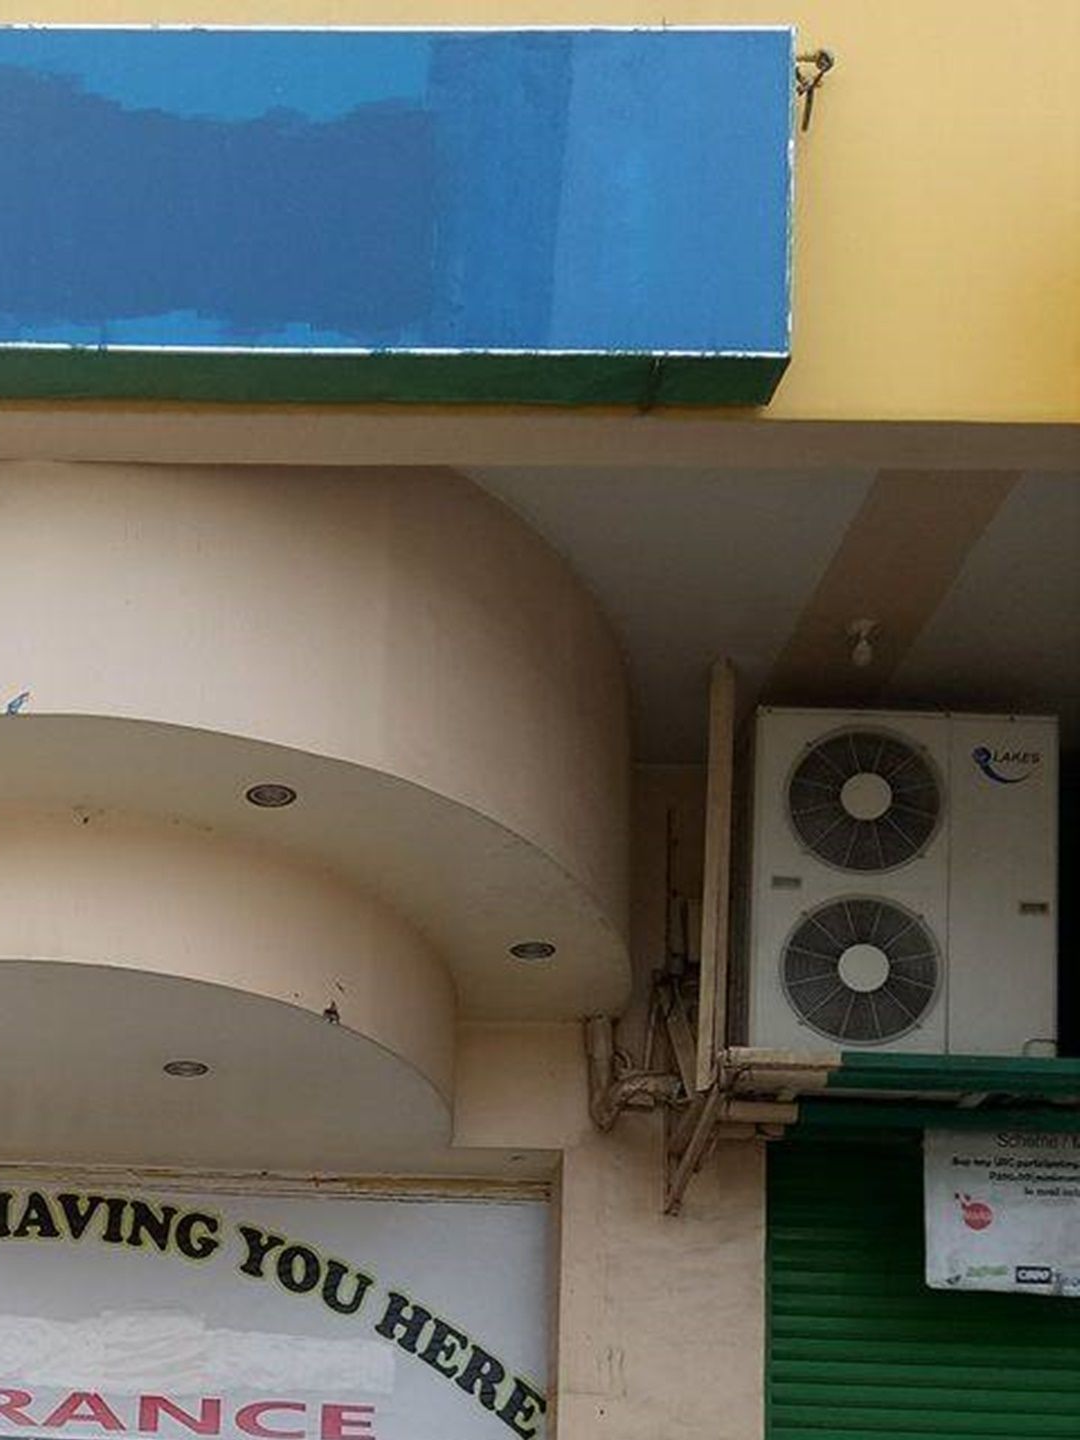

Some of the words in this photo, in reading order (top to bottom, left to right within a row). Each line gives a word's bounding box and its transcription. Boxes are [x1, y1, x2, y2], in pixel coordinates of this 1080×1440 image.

[993, 750, 1041, 764] LAKES
[237, 1225, 374, 1316] YOU
[373, 1291, 547, 1440] HERE
